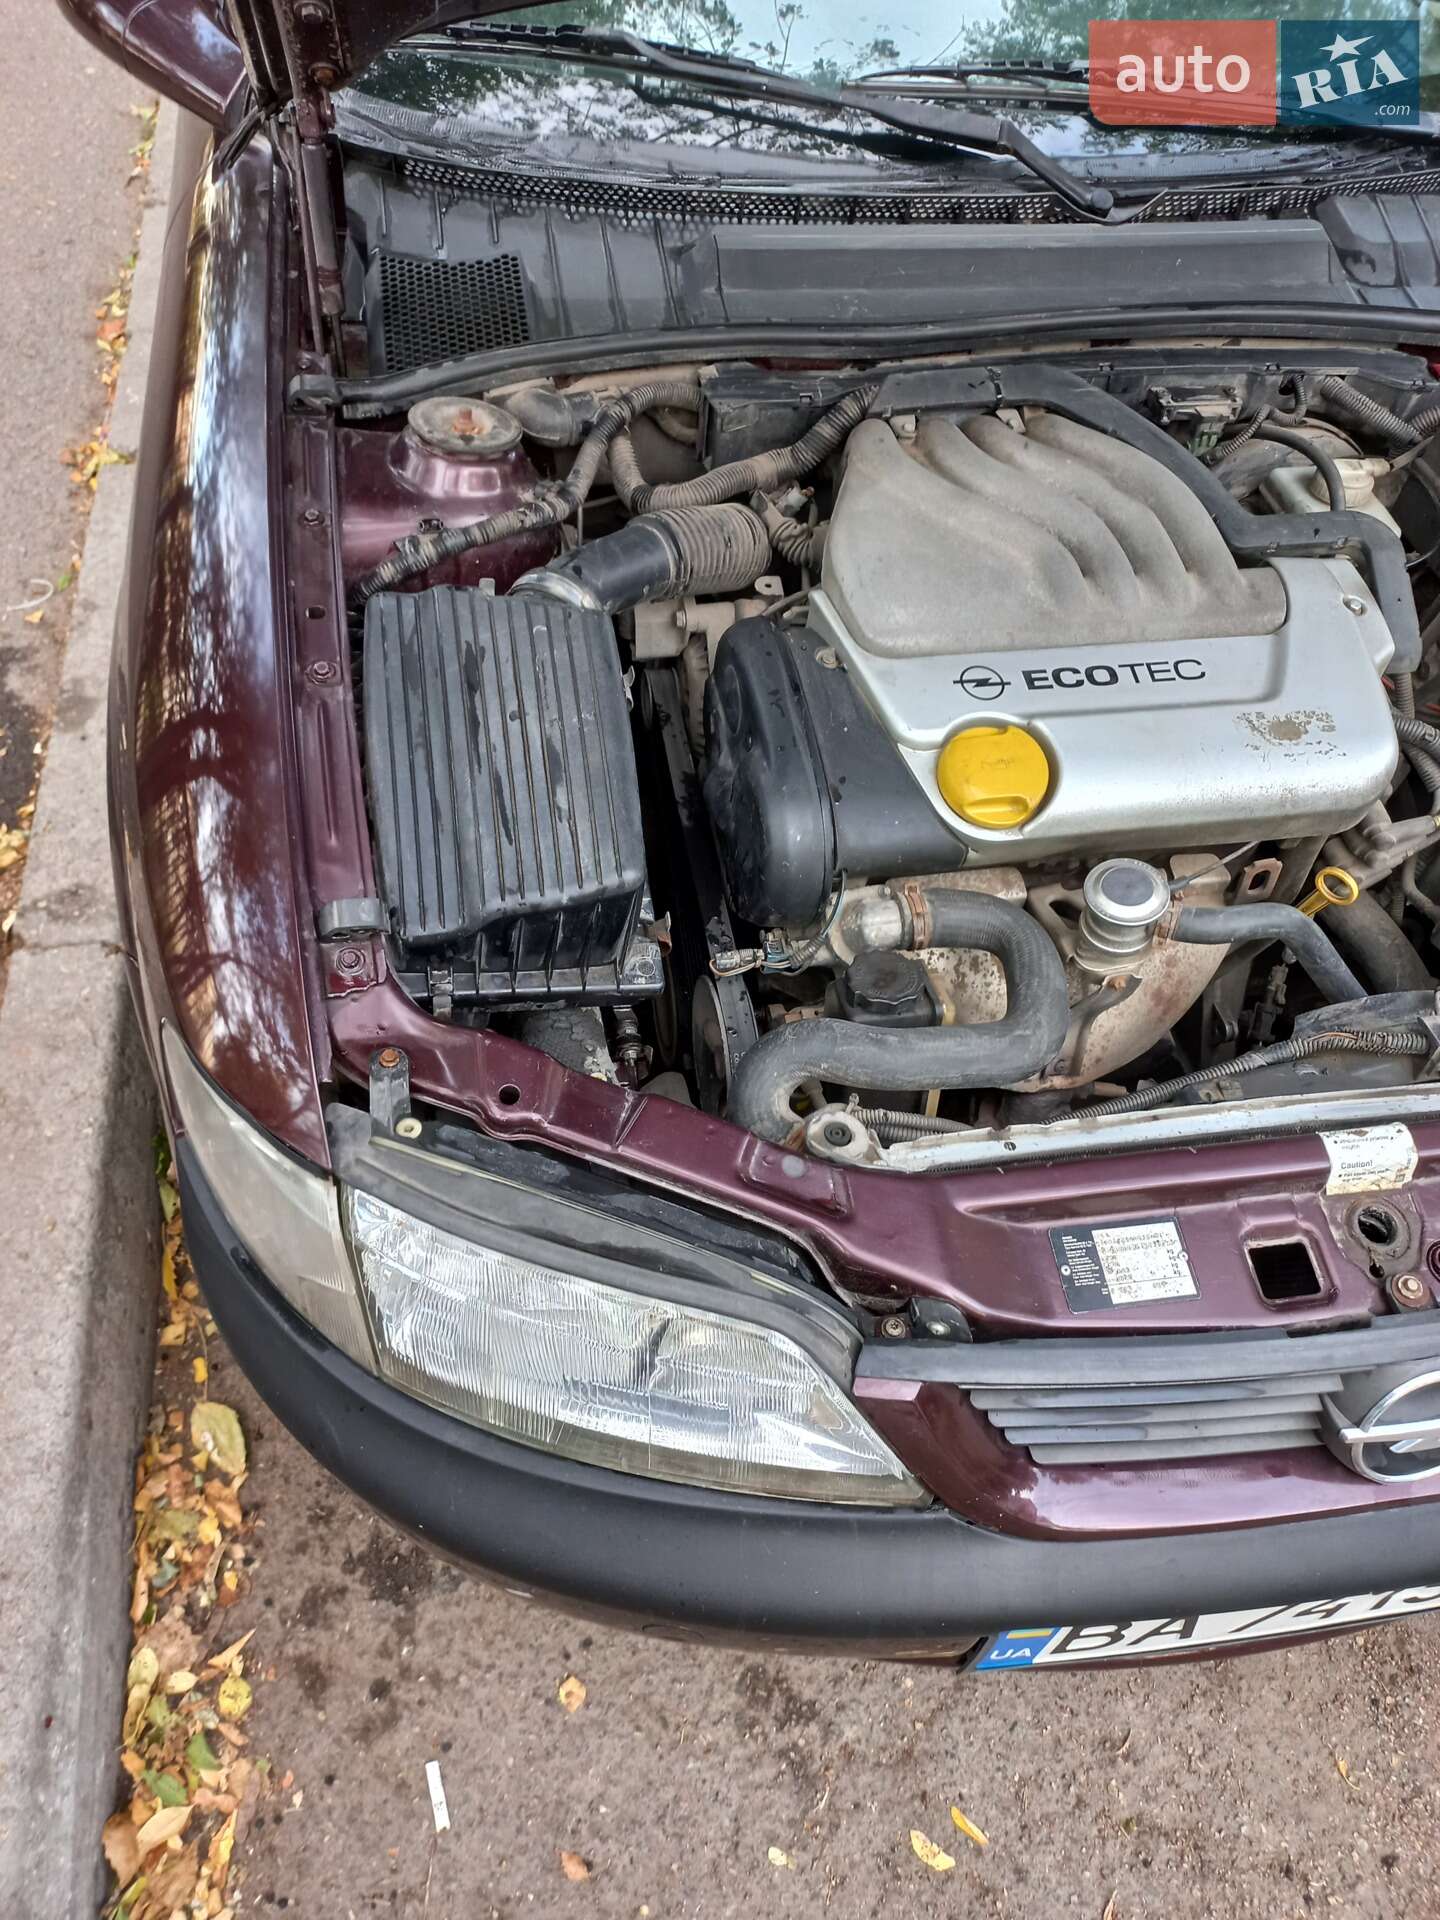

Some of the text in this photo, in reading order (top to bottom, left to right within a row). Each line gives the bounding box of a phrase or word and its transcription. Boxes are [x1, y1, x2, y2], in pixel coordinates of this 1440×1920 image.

[1022, 658, 1206, 691] ECOTEC
[1050, 1615, 1200, 1655] BA
[990, 1647, 1032, 1660] UA
